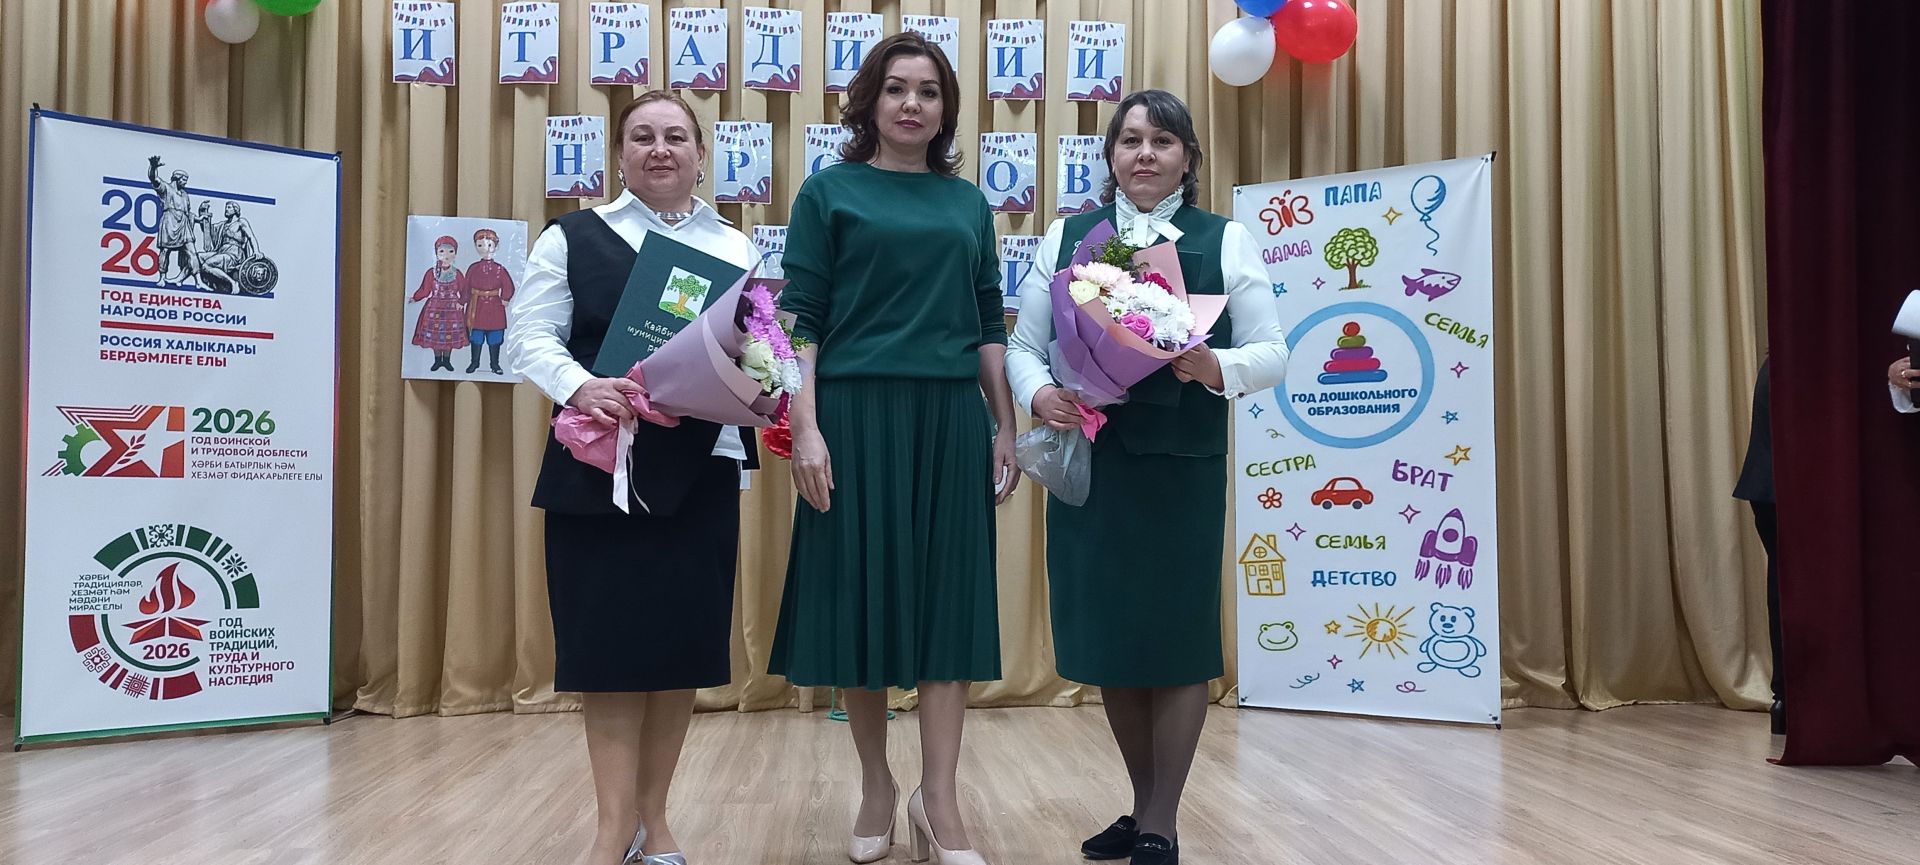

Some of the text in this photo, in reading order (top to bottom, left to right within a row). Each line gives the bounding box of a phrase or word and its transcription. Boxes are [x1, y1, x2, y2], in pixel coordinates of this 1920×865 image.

[1324, 181, 1382, 207] ПАПА
[101, 189, 163, 235] 20
[100, 232, 161, 277] 26
[101, 290, 222, 310] ГОД ЕДИНСТВА
[100, 304, 247, 326] НАРОДОВ РОССИИ
[627, 326, 669, 346] муницип
[644, 320, 676, 337] Кайби
[1424, 312, 1490, 349] СЕМЬЯ
[100, 335, 256, 355] РОССИЯ ХАЛЫКЛАРЫ
[100, 350, 227, 367] БЕРДӘМЛЕГЕ ЕЛЫ
[1291, 388, 1418, 404] ГОД ДОШКОЛЬНОГО
[1307, 403, 1401, 417] ОБРАЗОВАНИЯ
[192, 407, 276, 436] 2026
[191, 436, 271, 446] ГОД ВОИНСКОЙ
[191, 446, 308, 458] И ТРУДОВОЙ ДОБЛЕСТИ
[224, 460, 272, 470] БАТЫРЛЫК
[1245, 454, 1317, 478] СЕСТРА
[230, 471, 303, 481] ФИДАКАРЬЛЕГЕ
[305, 473, 323, 481] ЕЛЫ
[1391, 459, 1454, 492] БРАТ
[1315, 534, 1386, 550] СЕМЬЯ
[1310, 570, 1398, 588] ДЕТСТВО
[102, 603, 123, 611] ЕЛЫ
[219, 617, 243, 628] ГОД
[209, 627, 275, 640] ВОИНСКИХ
[143, 643, 190, 660] 2026
[209, 635, 278, 652] ТРАДИЦИЙ,
[209, 652, 260, 663] ТРУДА И
[208, 661, 295, 675] КУЛЬТУРНОГО
[208, 674, 273, 687] НАСЛЕДИЯ
